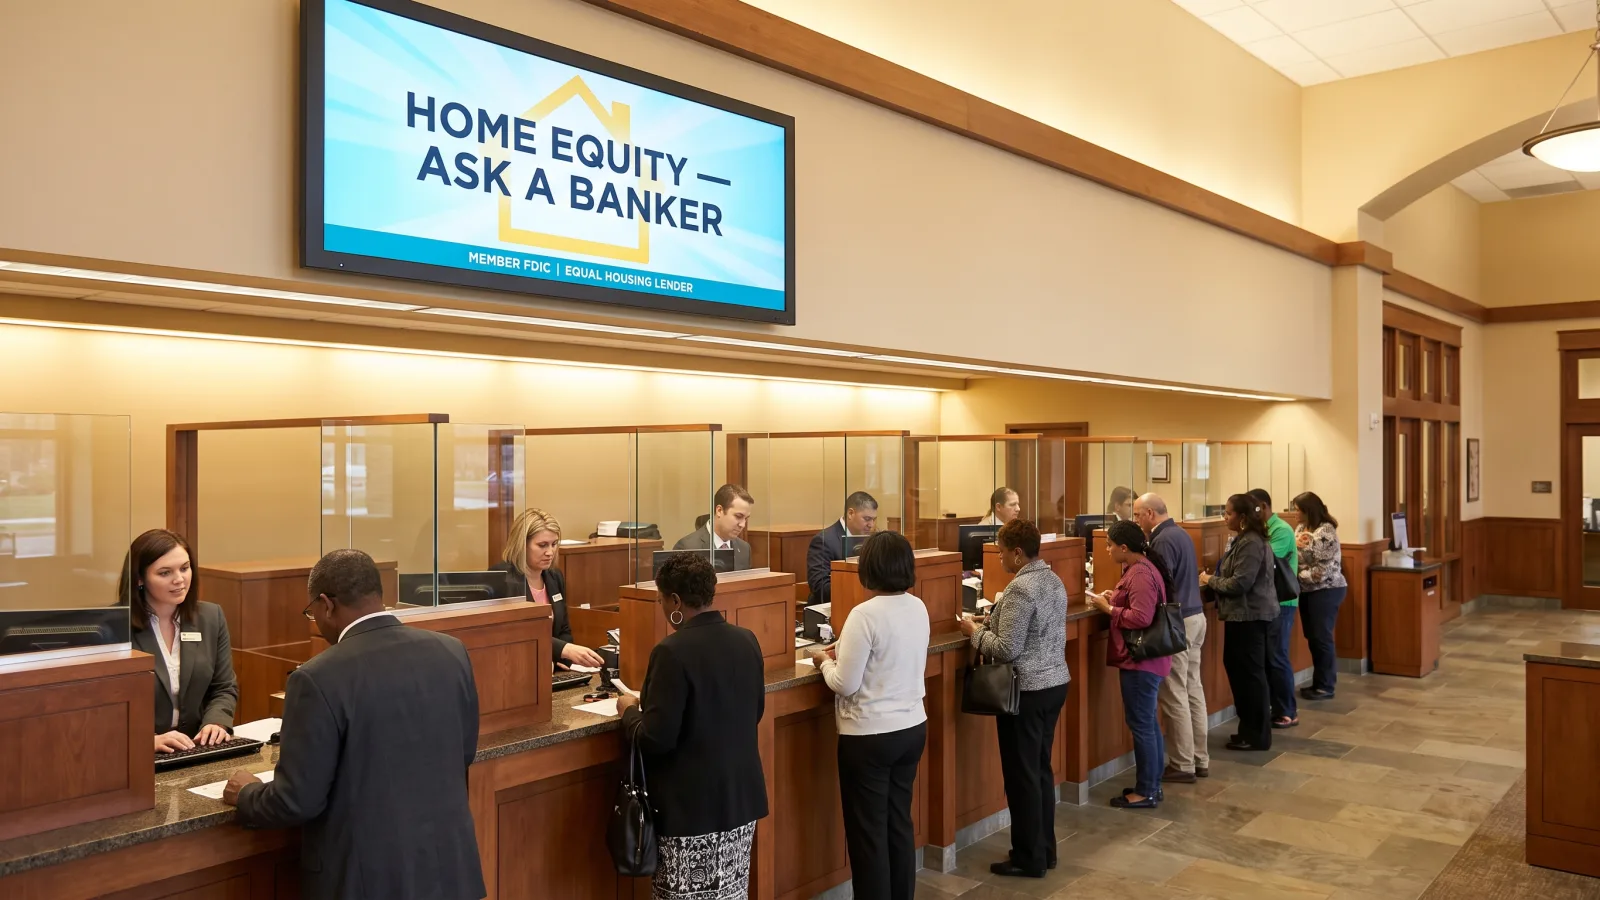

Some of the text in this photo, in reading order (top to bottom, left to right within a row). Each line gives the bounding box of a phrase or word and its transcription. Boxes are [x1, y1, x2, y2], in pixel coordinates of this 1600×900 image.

[407, 92, 537, 155] HOME
[551, 126, 688, 187] EQUITY
[416, 146, 724, 237] ASK A BANKER
[468, 251, 521, 269] MEMBER
[523, 259, 551, 273] FDIC
[565, 265, 603, 281] EQUAL
[605, 271, 652, 287] HOUSING
[654, 278, 694, 293] LENDER
